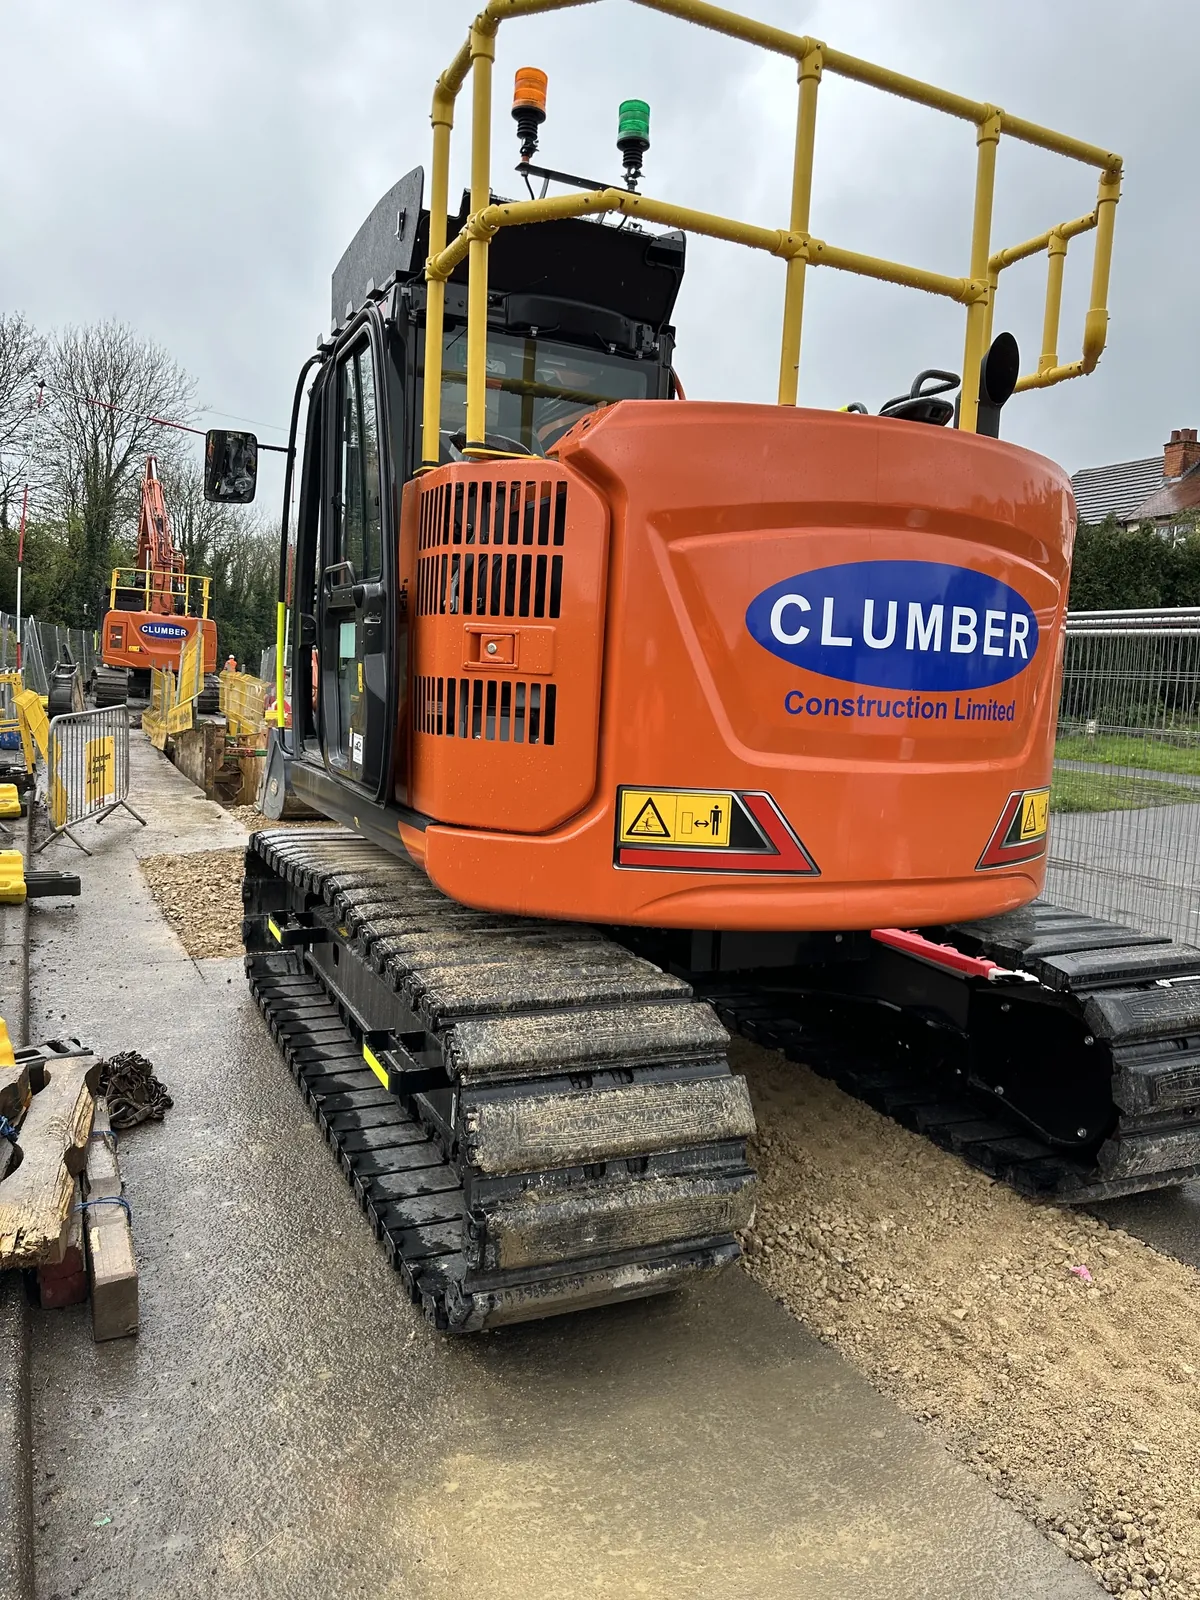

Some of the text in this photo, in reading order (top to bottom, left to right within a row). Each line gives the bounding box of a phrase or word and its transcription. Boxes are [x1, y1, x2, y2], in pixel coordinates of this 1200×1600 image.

[141, 625, 187, 637] CLUMBER
[769, 593, 1030, 660] CLUMBER
[784, 690, 1016, 722] Construction Limited
